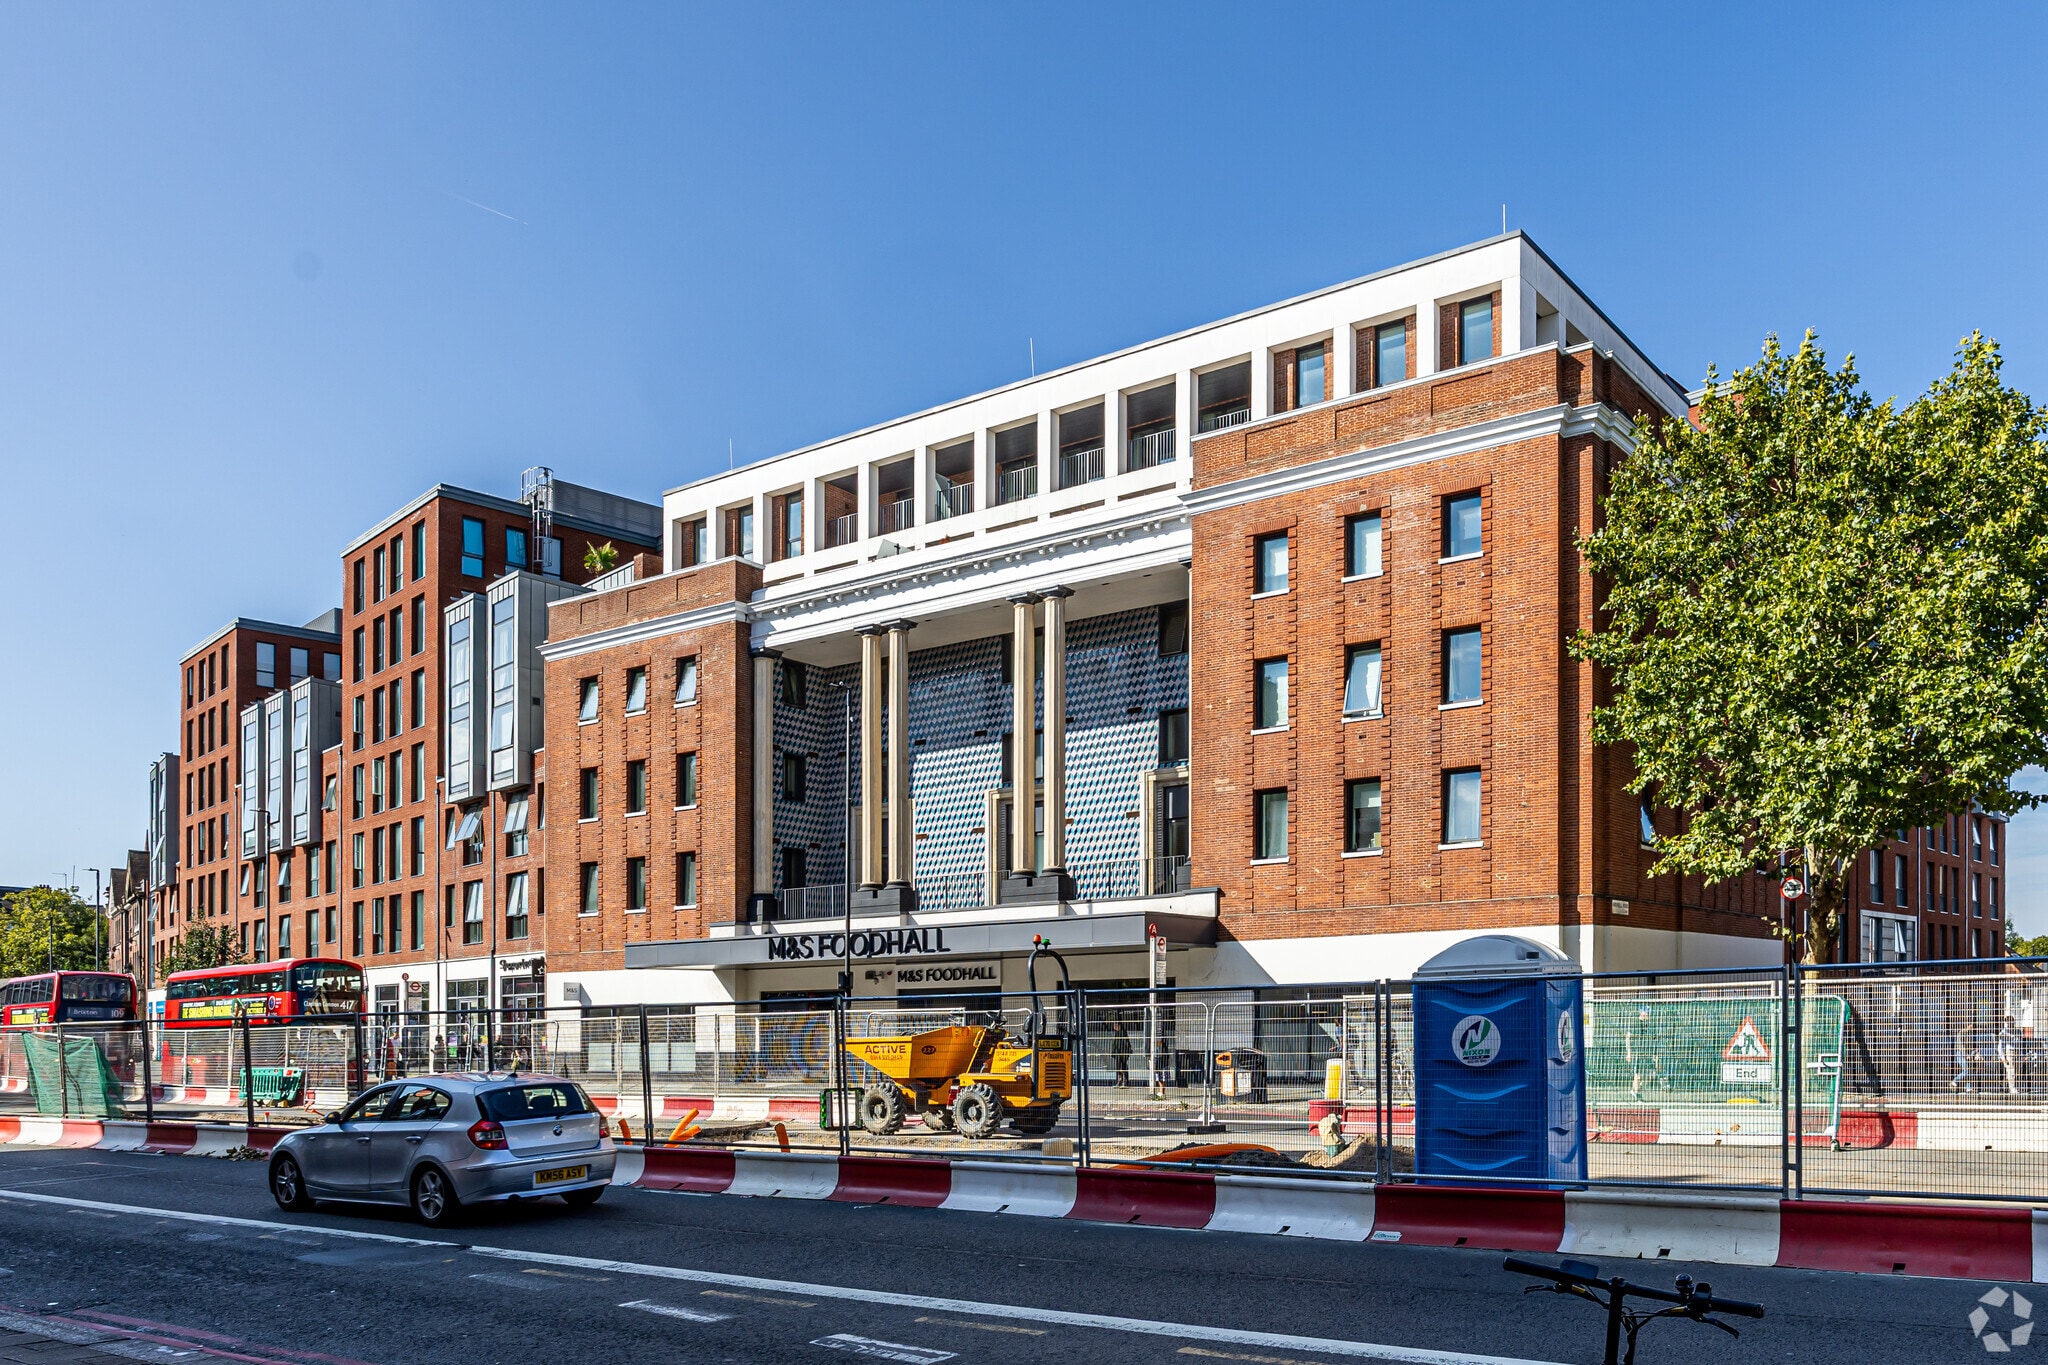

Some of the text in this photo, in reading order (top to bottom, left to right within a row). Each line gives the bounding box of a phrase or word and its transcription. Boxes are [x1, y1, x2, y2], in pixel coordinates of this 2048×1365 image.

[769, 928, 951, 960] M&S FOODHALL
[897, 967, 996, 983] M&S FOODHALL
[340, 1000, 354, 1010] 417
[111, 1009, 124, 1018] 109
[1736, 1067, 1758, 1078] End
[540, 1167, 582, 1181] KM56 ASV
